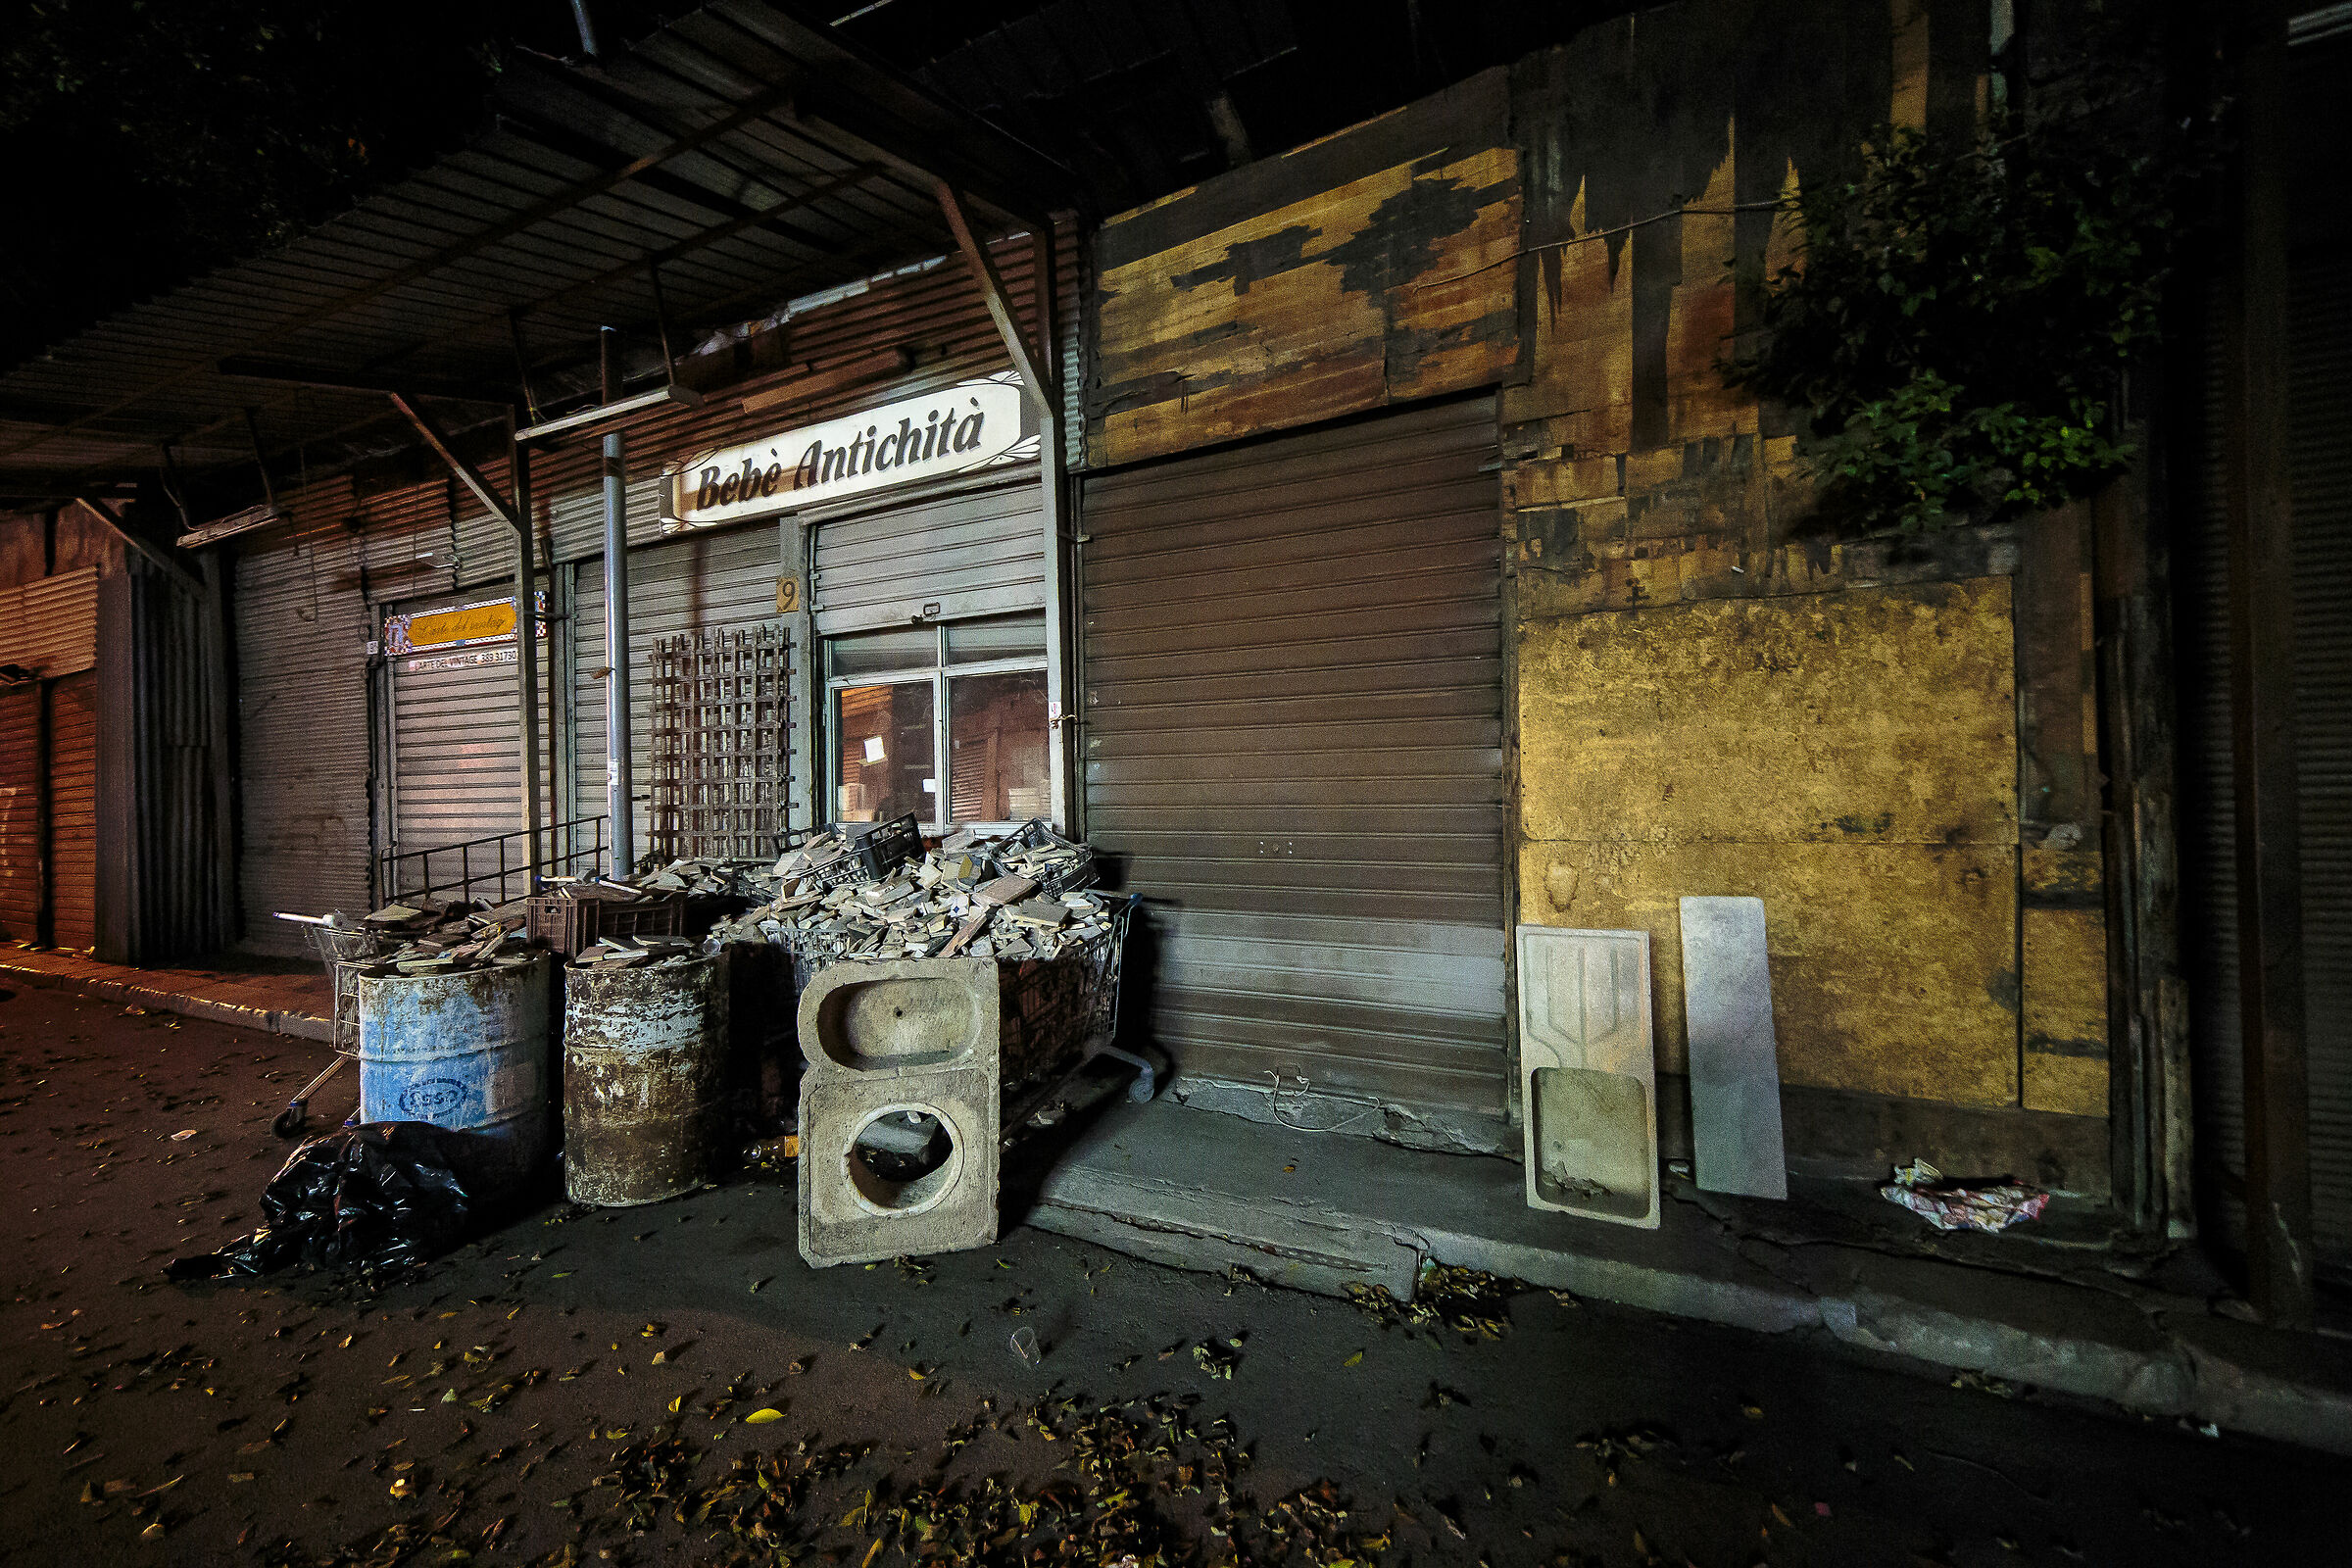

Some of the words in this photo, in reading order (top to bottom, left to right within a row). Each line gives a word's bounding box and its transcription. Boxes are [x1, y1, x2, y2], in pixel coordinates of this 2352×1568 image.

[696, 448, 782, 511] Bebè
[793, 397, 984, 491] Antichità
[783, 581, 795, 610] 9
[449, 655, 477, 667] VINTAGE
